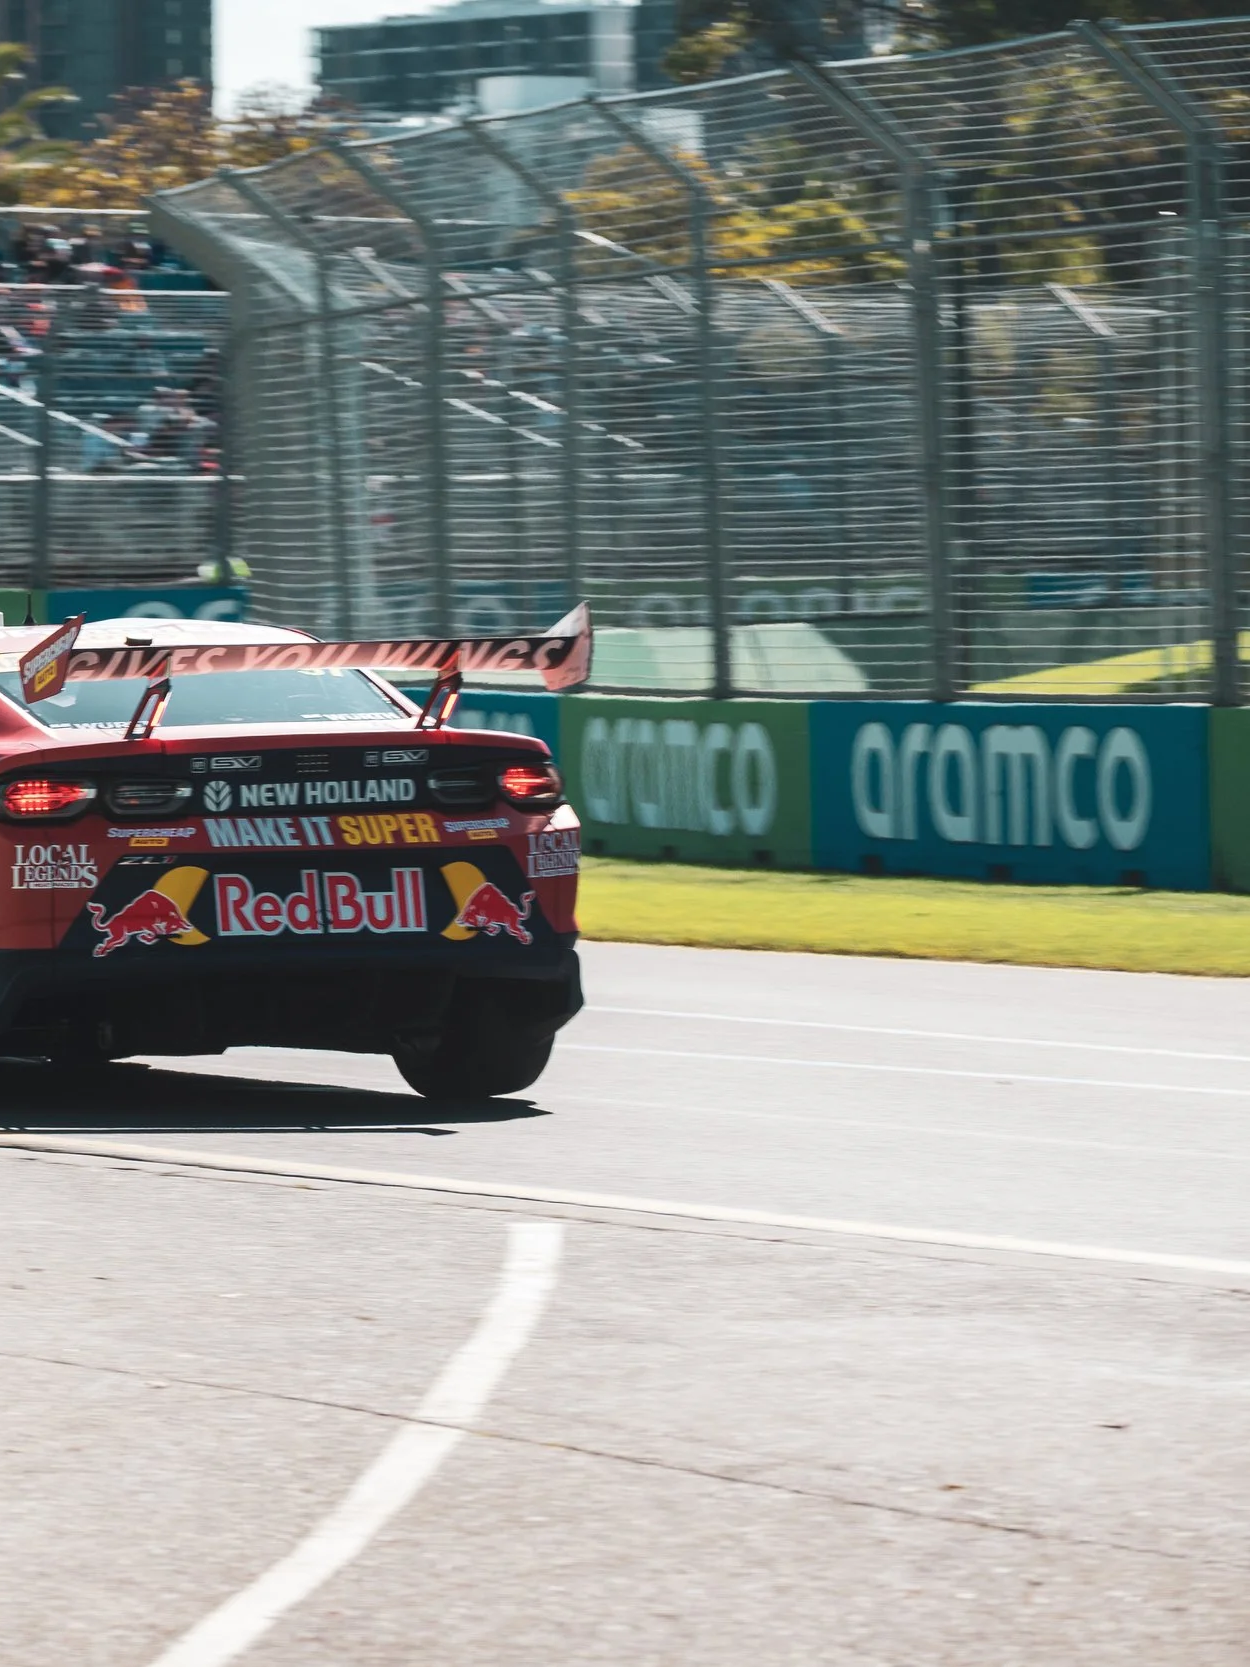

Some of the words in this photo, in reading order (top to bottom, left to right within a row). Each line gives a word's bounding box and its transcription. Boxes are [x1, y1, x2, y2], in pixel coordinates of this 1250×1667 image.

[371, 639, 565, 671] WINGS
[581, 717, 778, 836] aramco
[851, 722, 1151, 850] aramco
[239, 782, 299, 807] NEW
[304, 779, 416, 804] HOLLAND
[107, 827, 197, 838] SUPERCHEAP
[203, 817, 302, 848] MAKE
[300, 816, 335, 846] IT
[337, 813, 441, 845] SUPER
[14, 844, 94, 866] LOCAL
[11, 865, 98, 889] LEGENDS
[213, 869, 324, 936] Red
[323, 867, 428, 934] Bull
